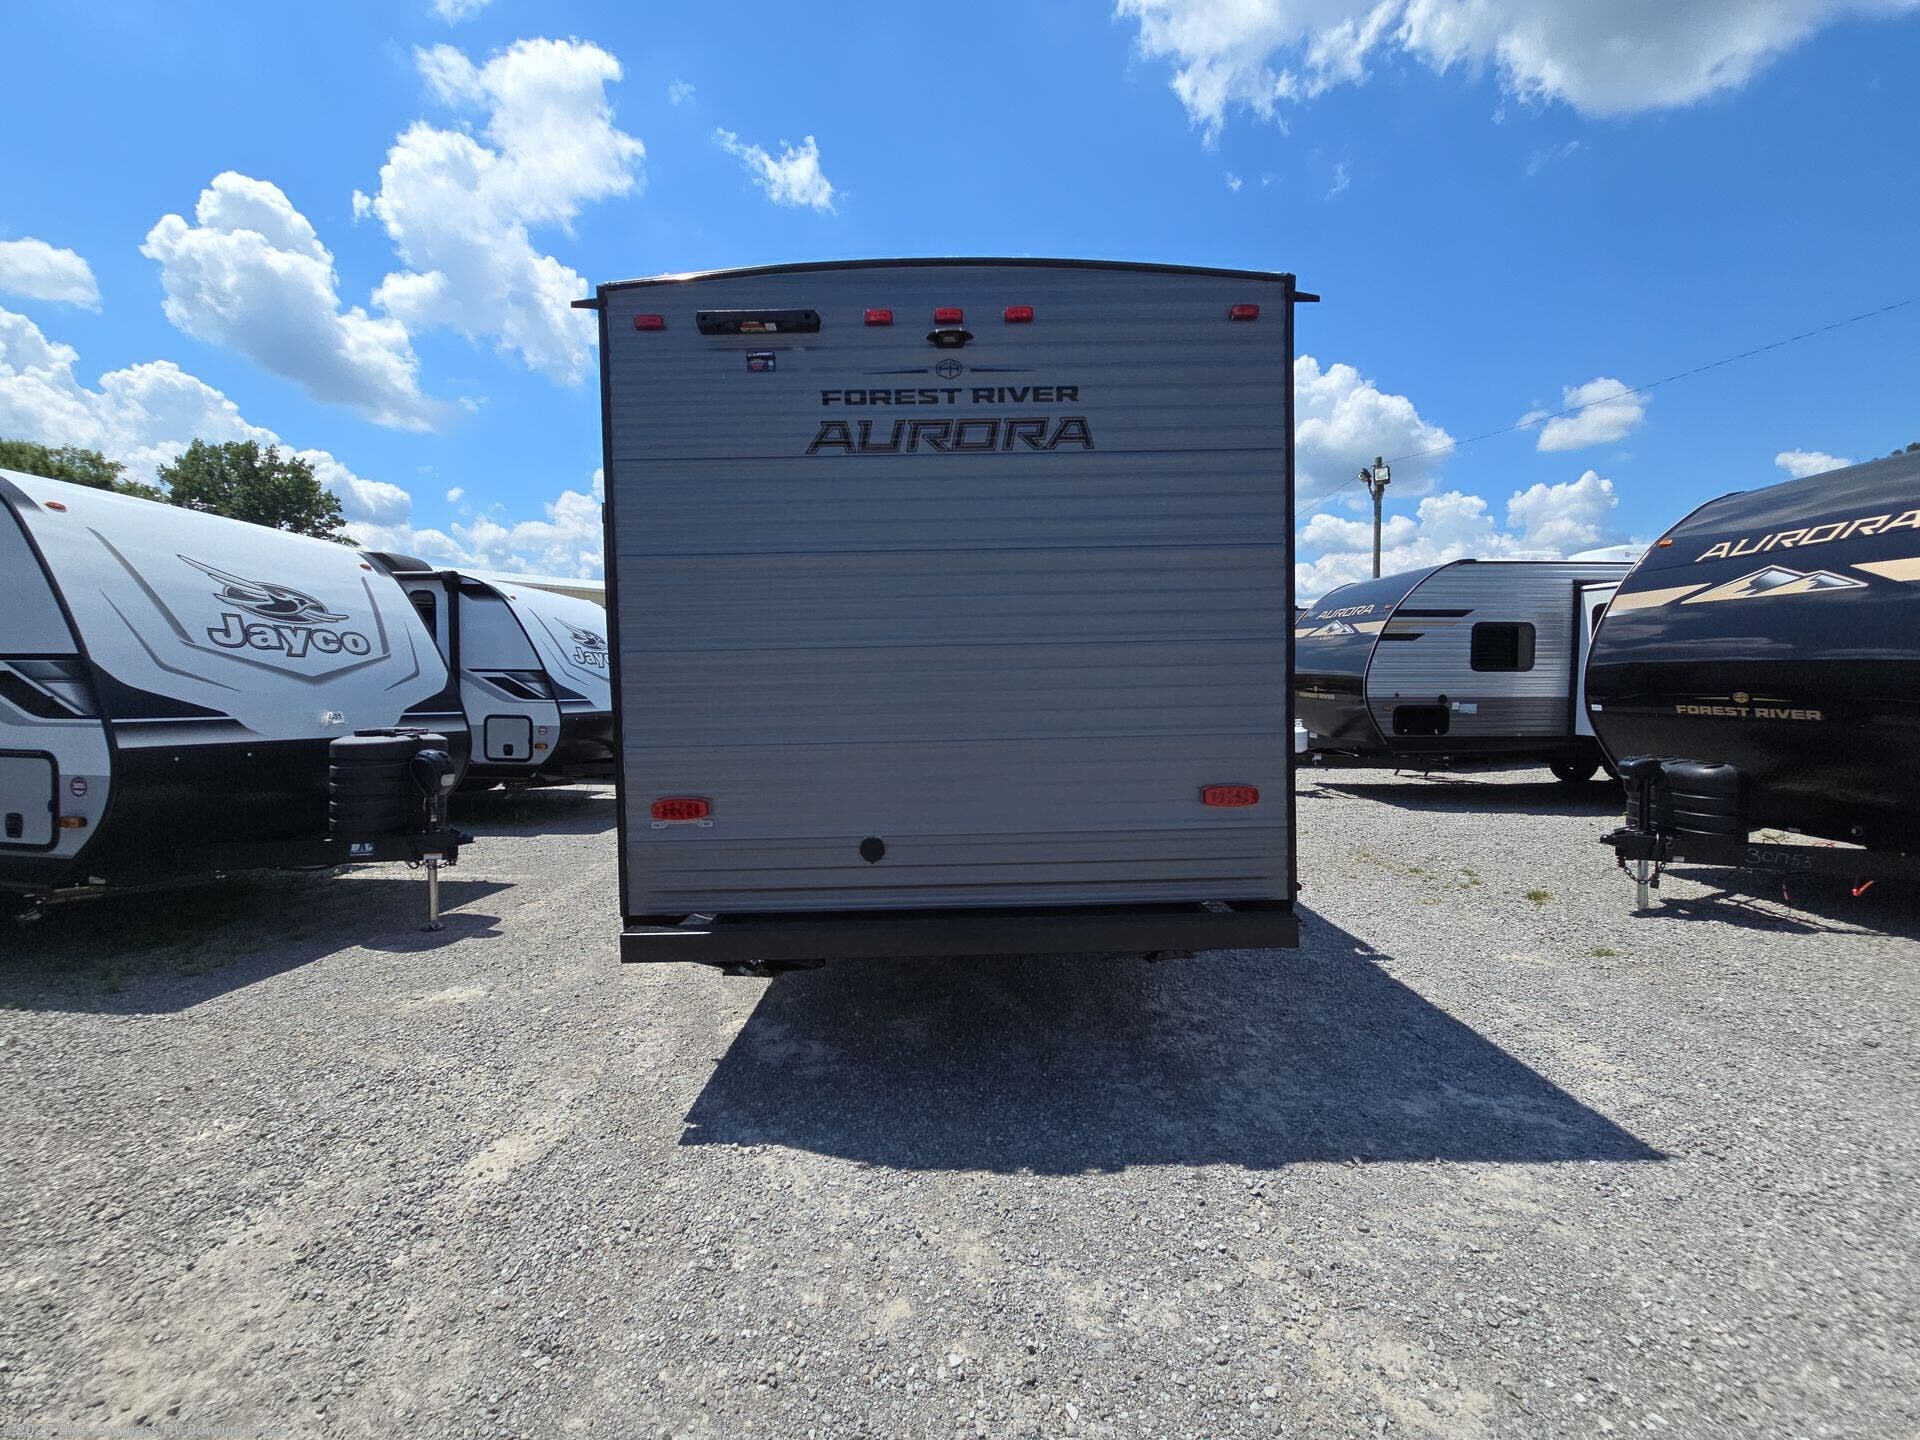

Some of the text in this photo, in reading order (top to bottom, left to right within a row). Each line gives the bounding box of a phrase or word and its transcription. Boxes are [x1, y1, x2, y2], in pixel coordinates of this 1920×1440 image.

[820, 386, 1079, 406] FOREST RIVER
[806, 417, 1095, 454] AURORA
[1694, 509, 1920, 563] AURORA
[1315, 604, 1375, 619] AURORA
[207, 612, 371, 658] Jayco
[1675, 704, 1822, 721] FOREST RIVER
[1744, 847, 1817, 869] 301755
